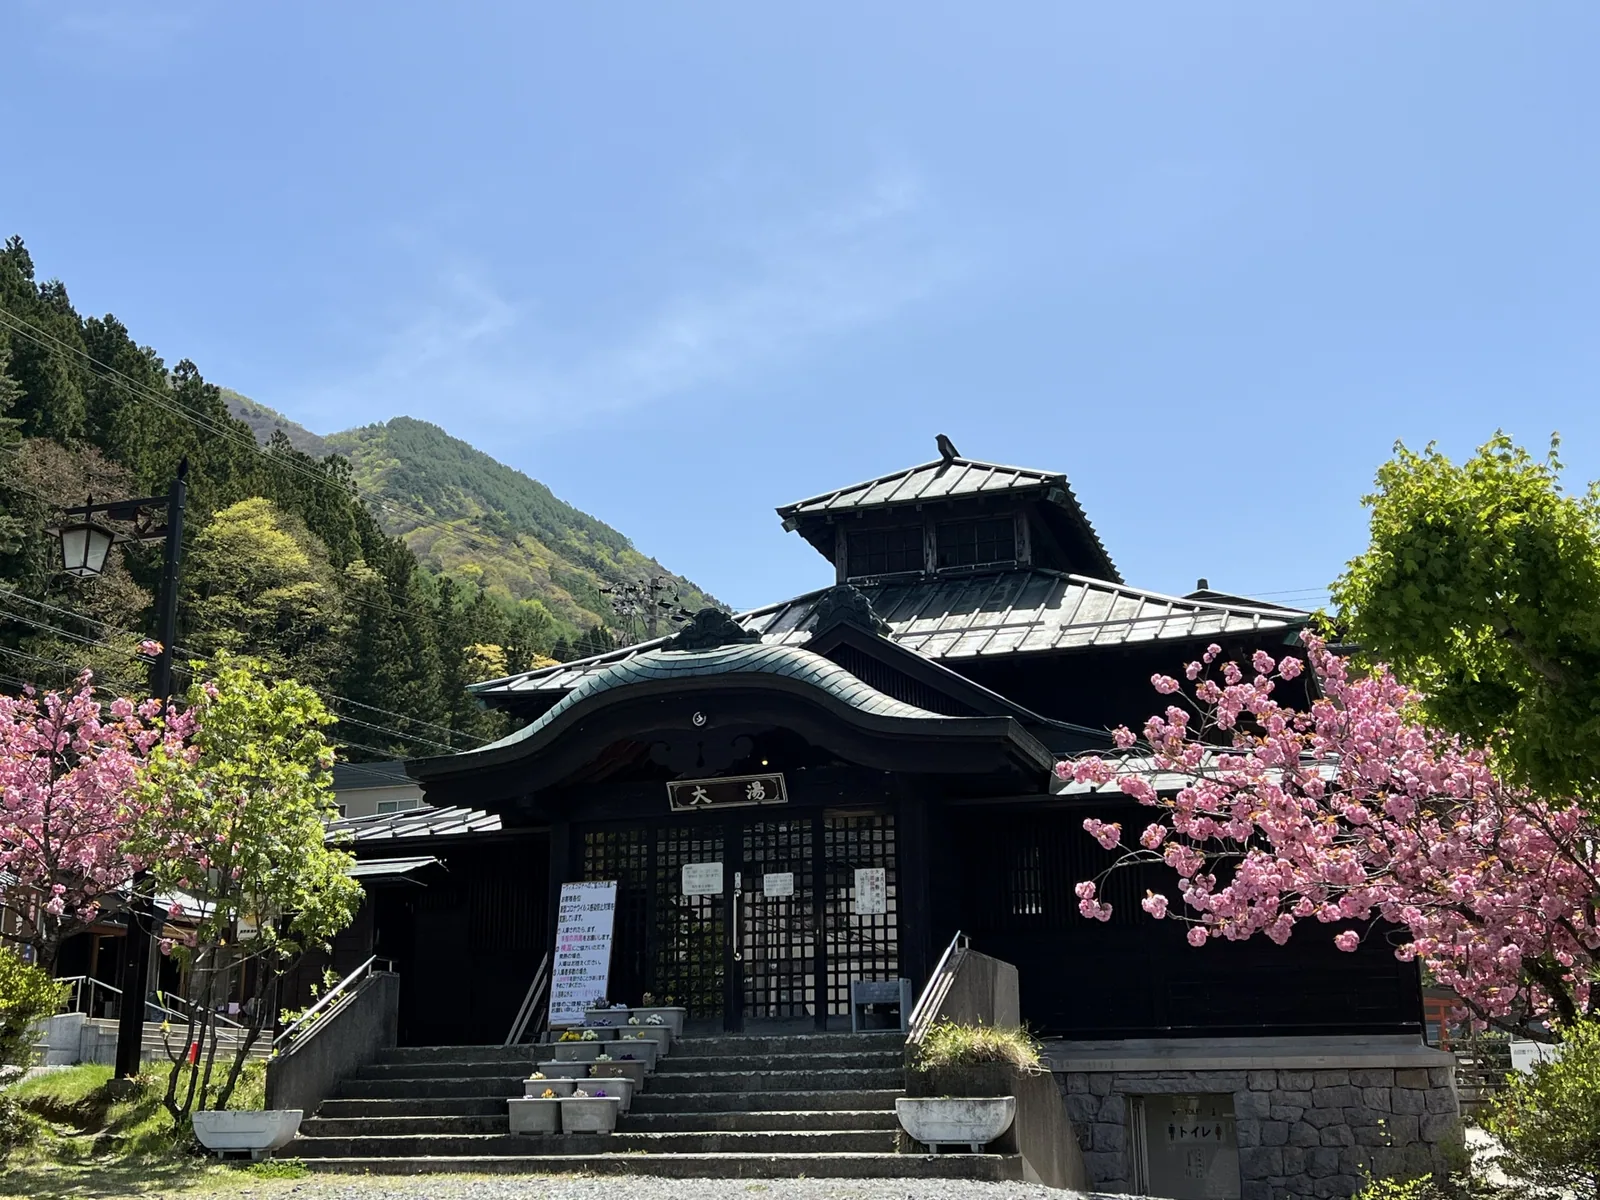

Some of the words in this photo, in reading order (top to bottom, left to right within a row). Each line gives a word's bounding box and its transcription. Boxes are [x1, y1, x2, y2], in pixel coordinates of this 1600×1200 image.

[690, 781, 766, 805] 大湯
[1180, 1126, 1211, 1138] トイレ
